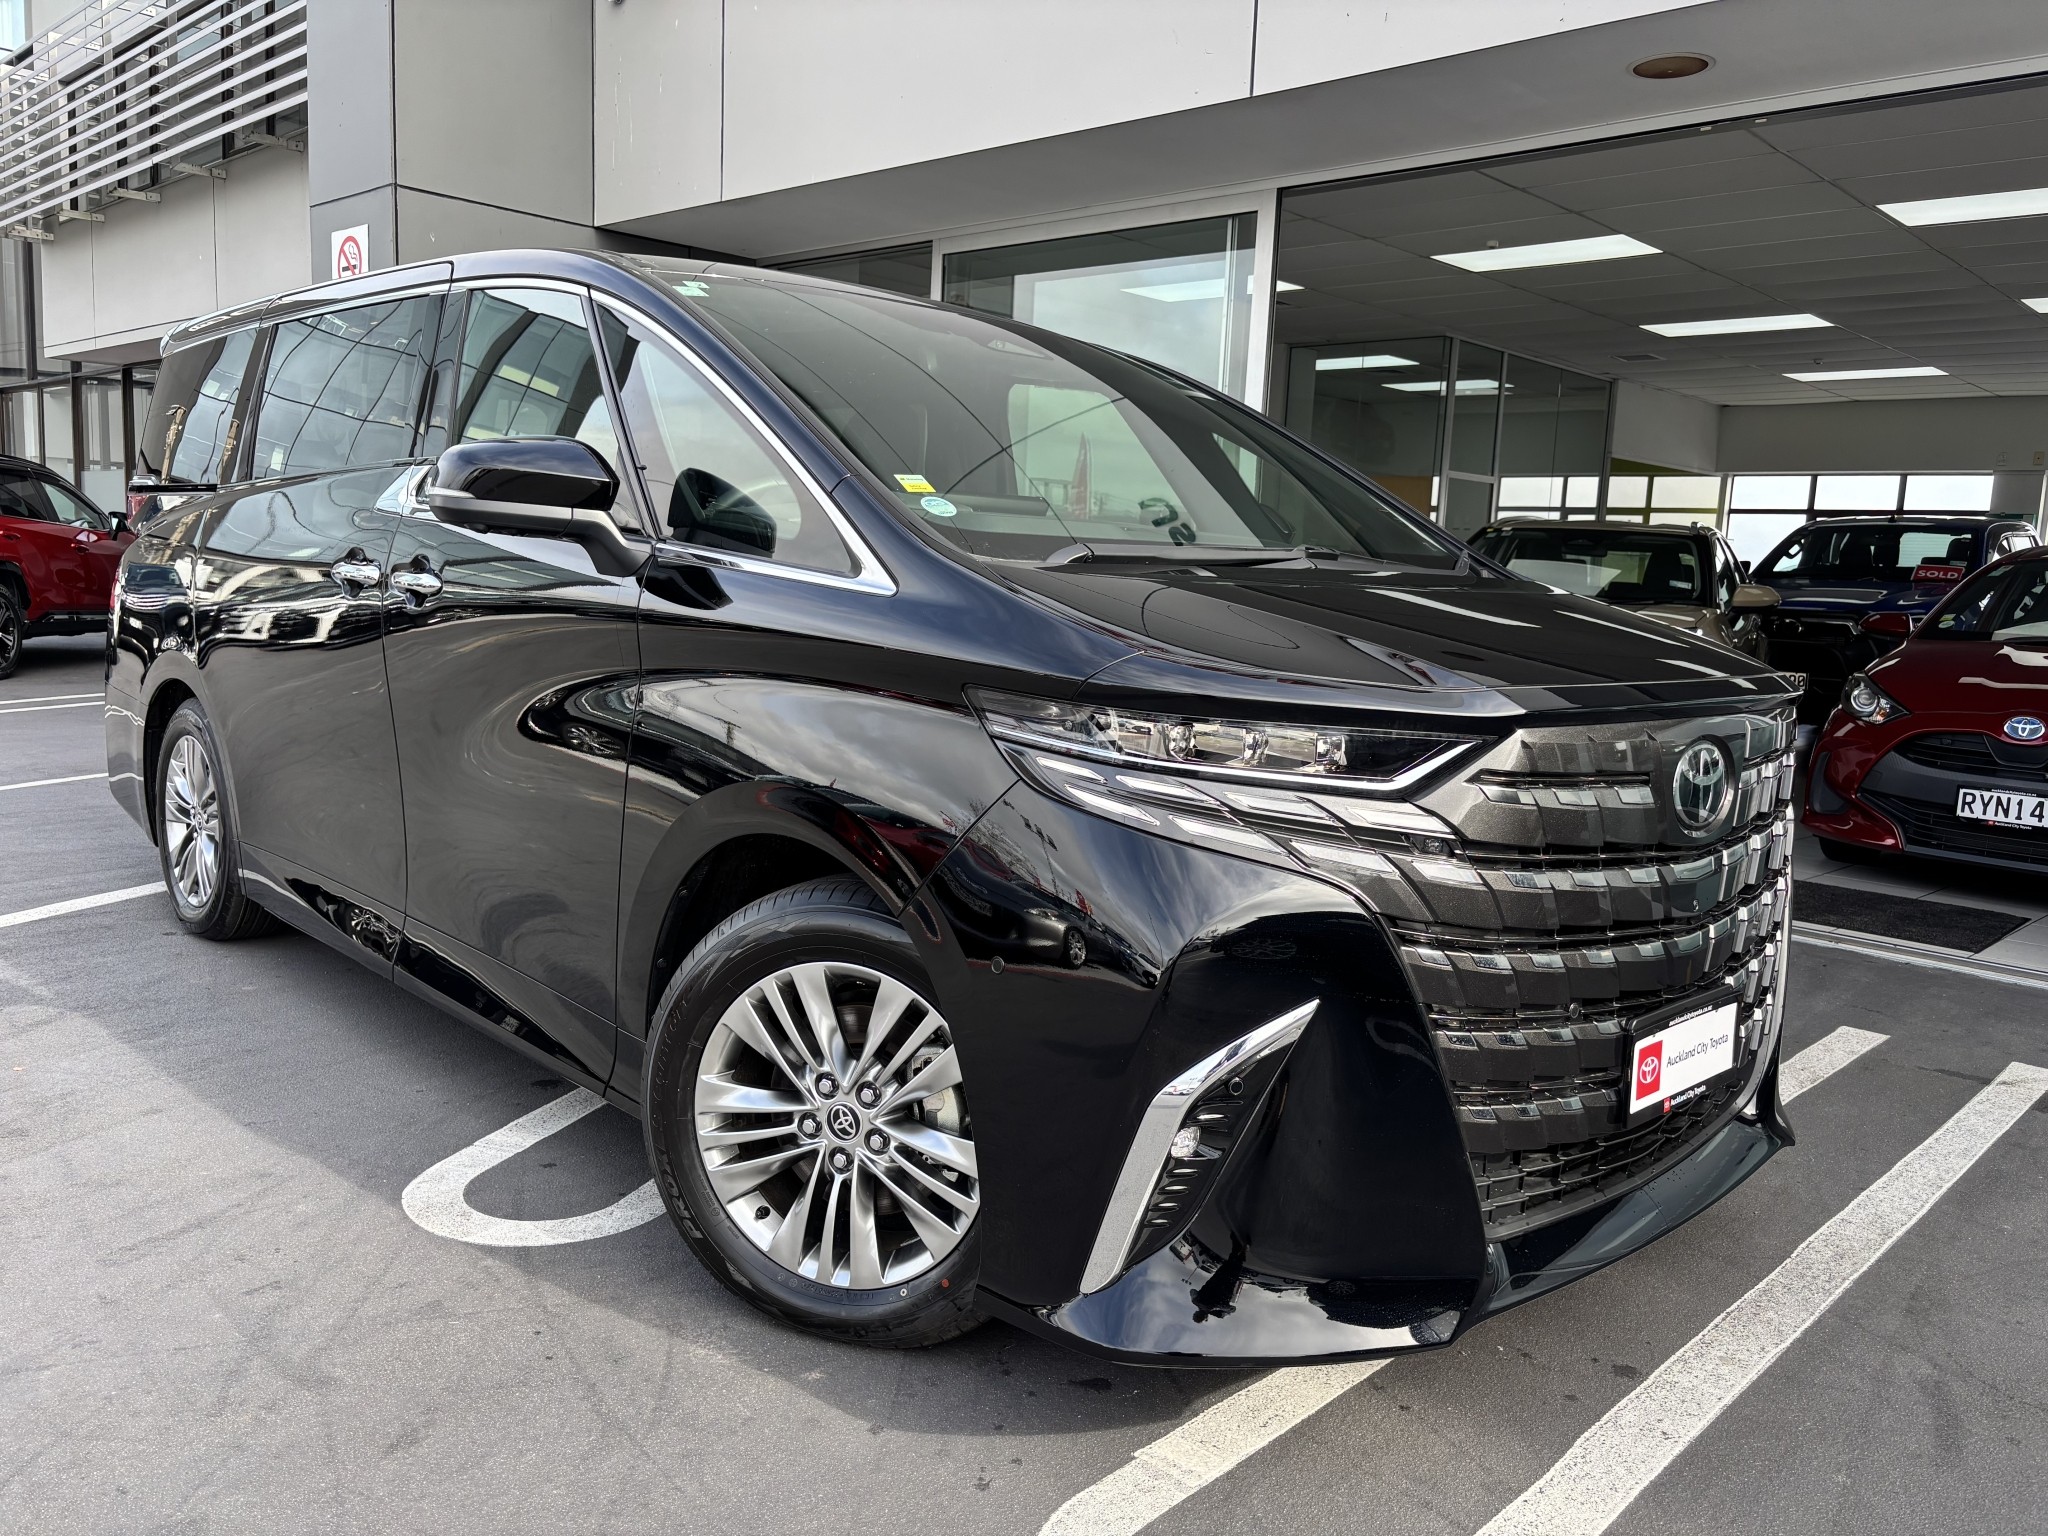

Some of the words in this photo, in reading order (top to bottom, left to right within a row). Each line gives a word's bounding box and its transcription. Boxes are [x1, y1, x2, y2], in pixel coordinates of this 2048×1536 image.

[1917, 570, 1958, 579] SOLD
[1667, 1045, 1696, 1068] Auckland
[1696, 1042, 1709, 1055] City
[1709, 1033, 1729, 1050] Toyota
